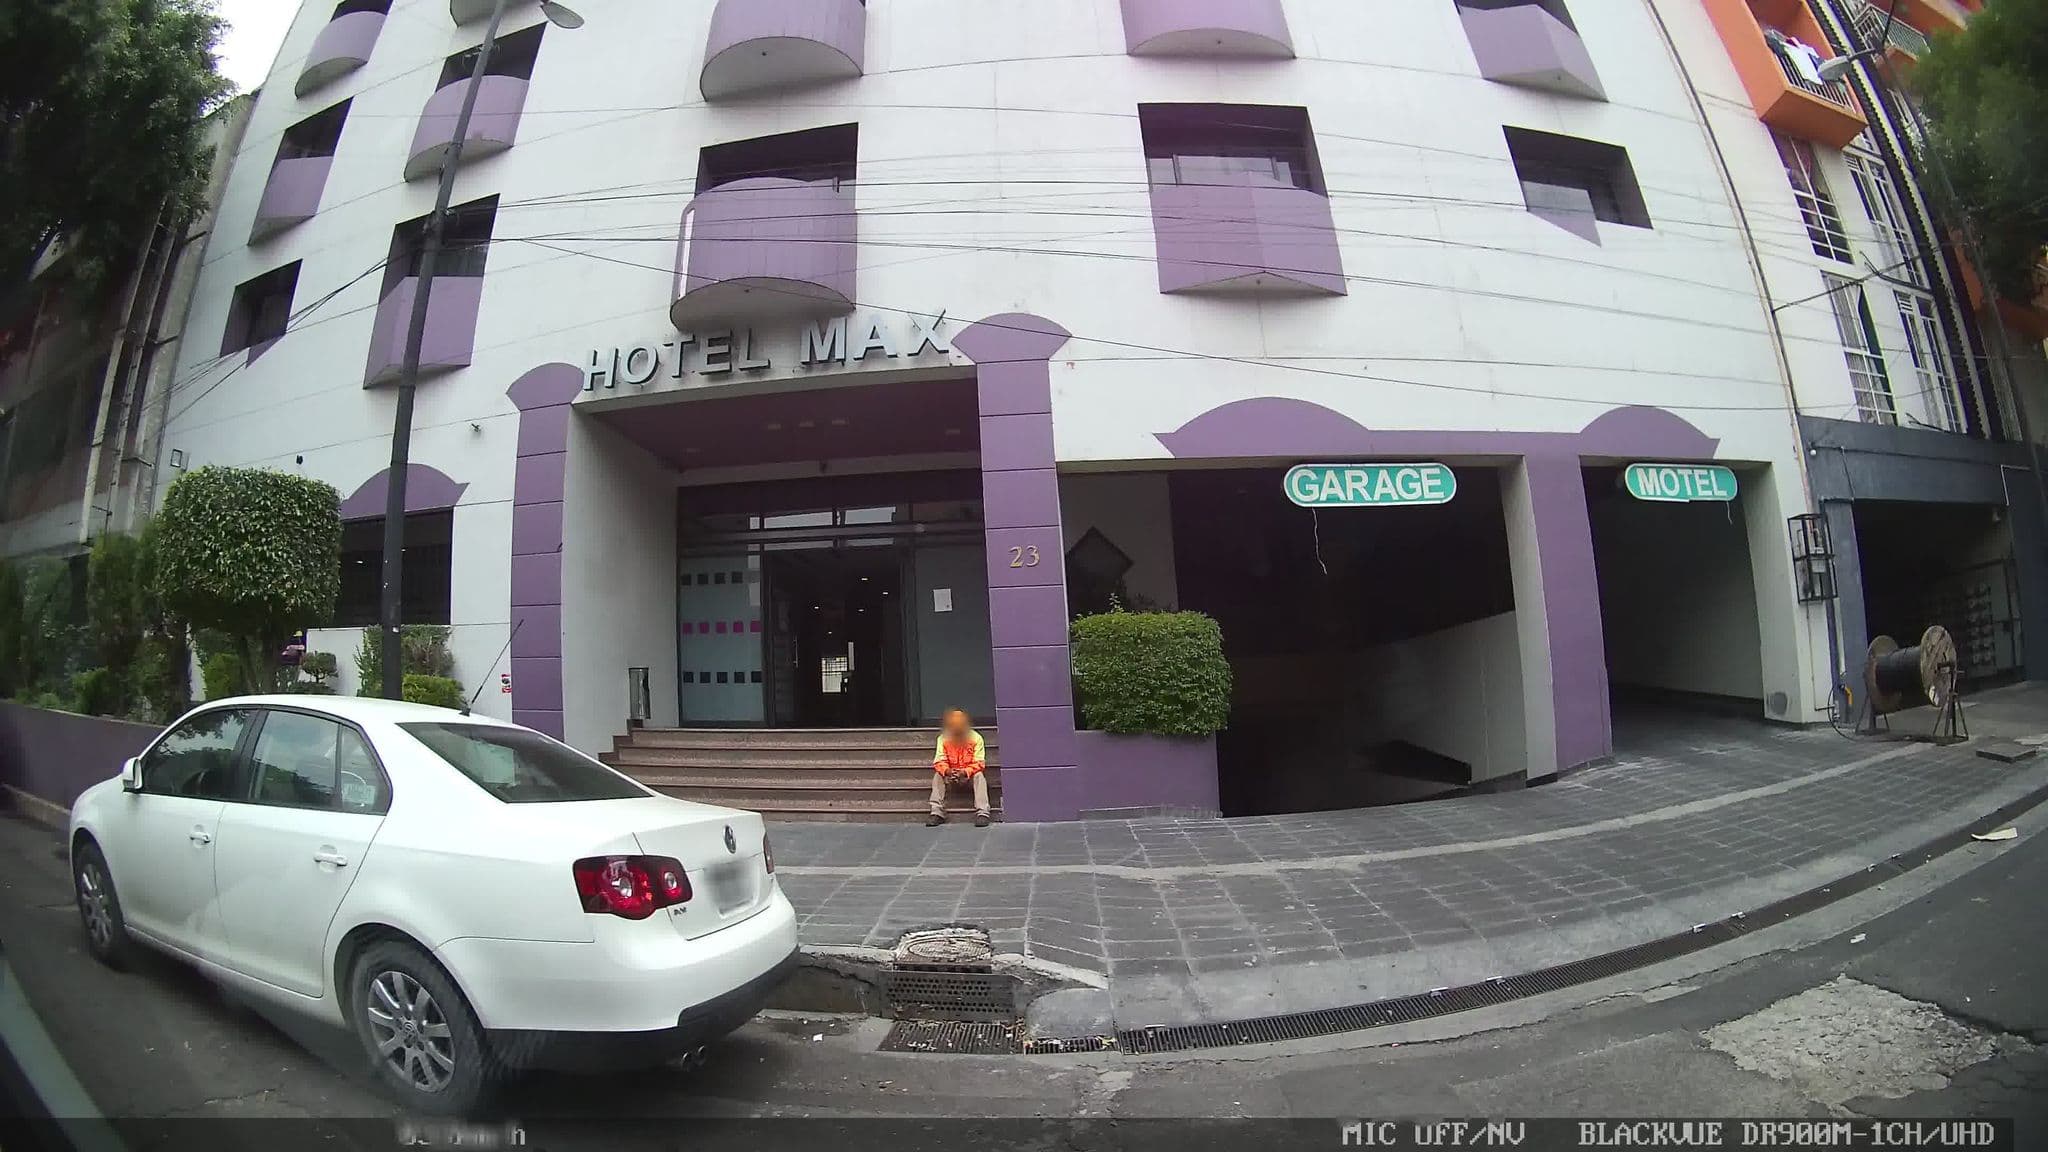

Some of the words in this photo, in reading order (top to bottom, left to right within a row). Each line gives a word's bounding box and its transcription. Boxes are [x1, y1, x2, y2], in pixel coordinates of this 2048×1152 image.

[582, 328, 771, 392] HOTEL
[800, 308, 950, 367] MAX
[1291, 467, 1446, 502] GARAGE
[1636, 467, 1728, 497] MOTEL
[1009, 545, 1041, 569] 23
